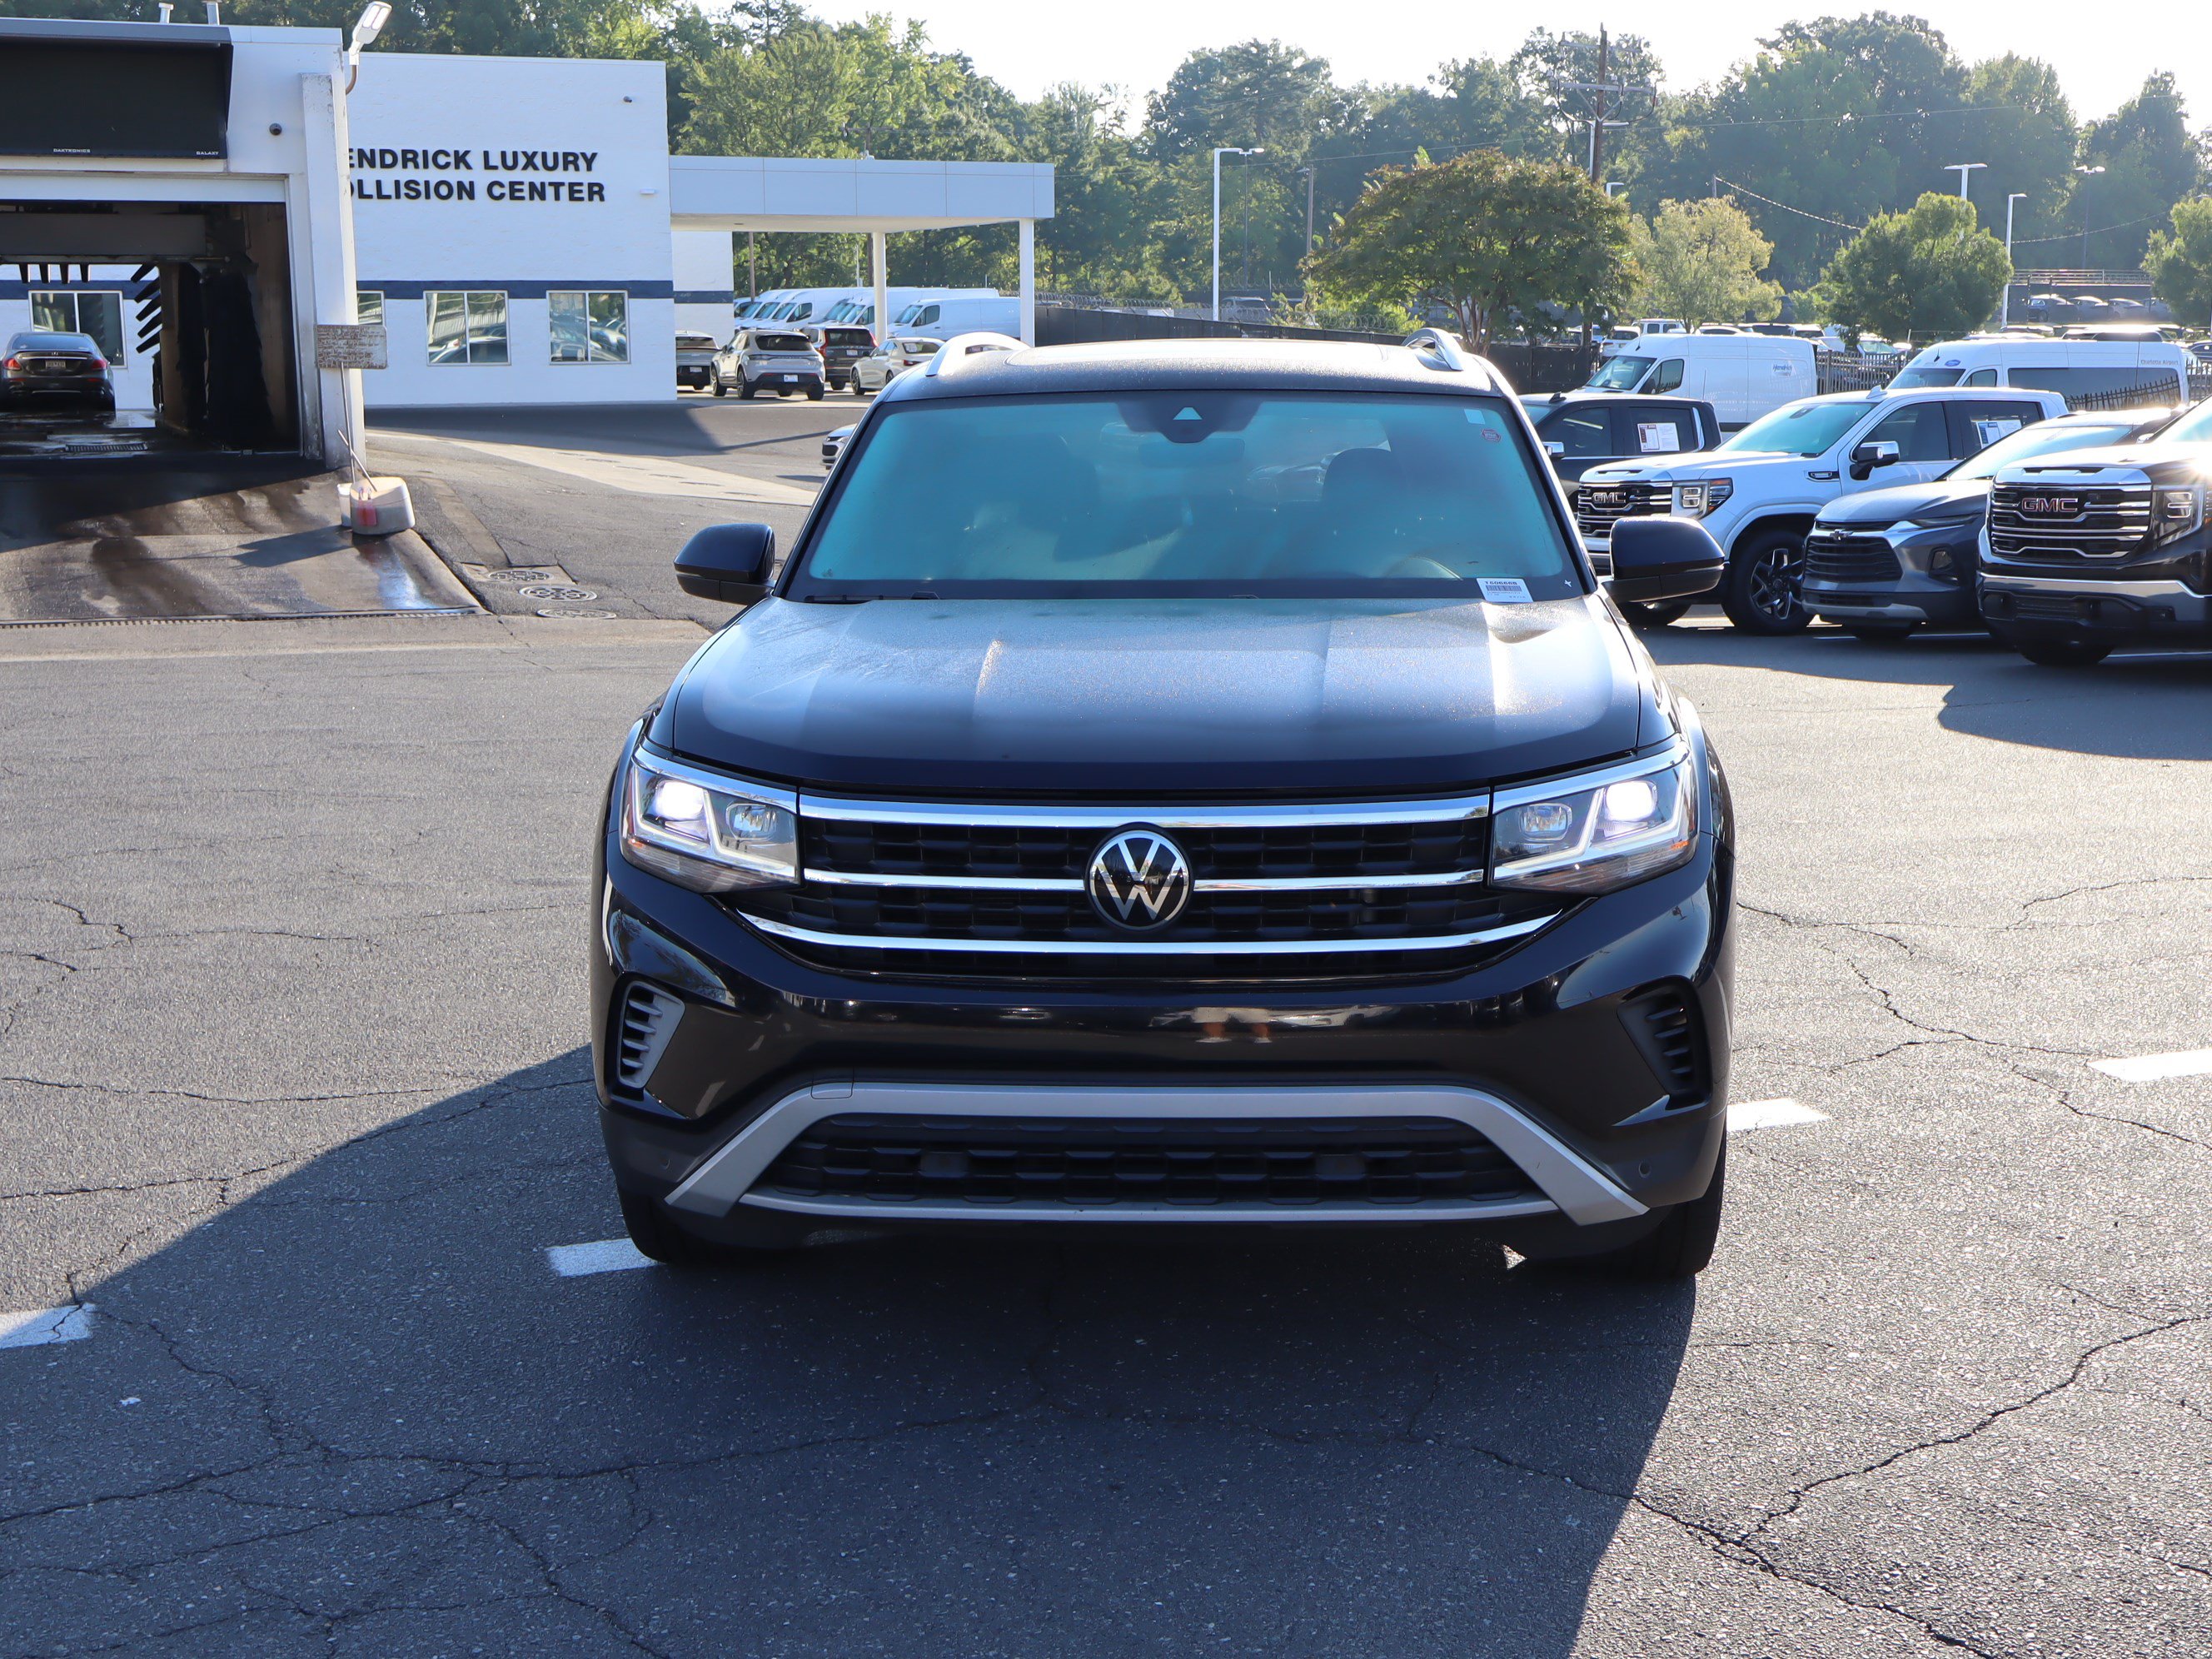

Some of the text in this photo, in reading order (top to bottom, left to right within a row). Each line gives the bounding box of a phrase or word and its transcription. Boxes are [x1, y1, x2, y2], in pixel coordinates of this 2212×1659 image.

[483, 151, 598, 172] LUXURY
[351, 179, 605, 202] LLISION CENTER
[1592, 491, 1627, 503] GMC
[2021, 497, 2079, 512] GMC
